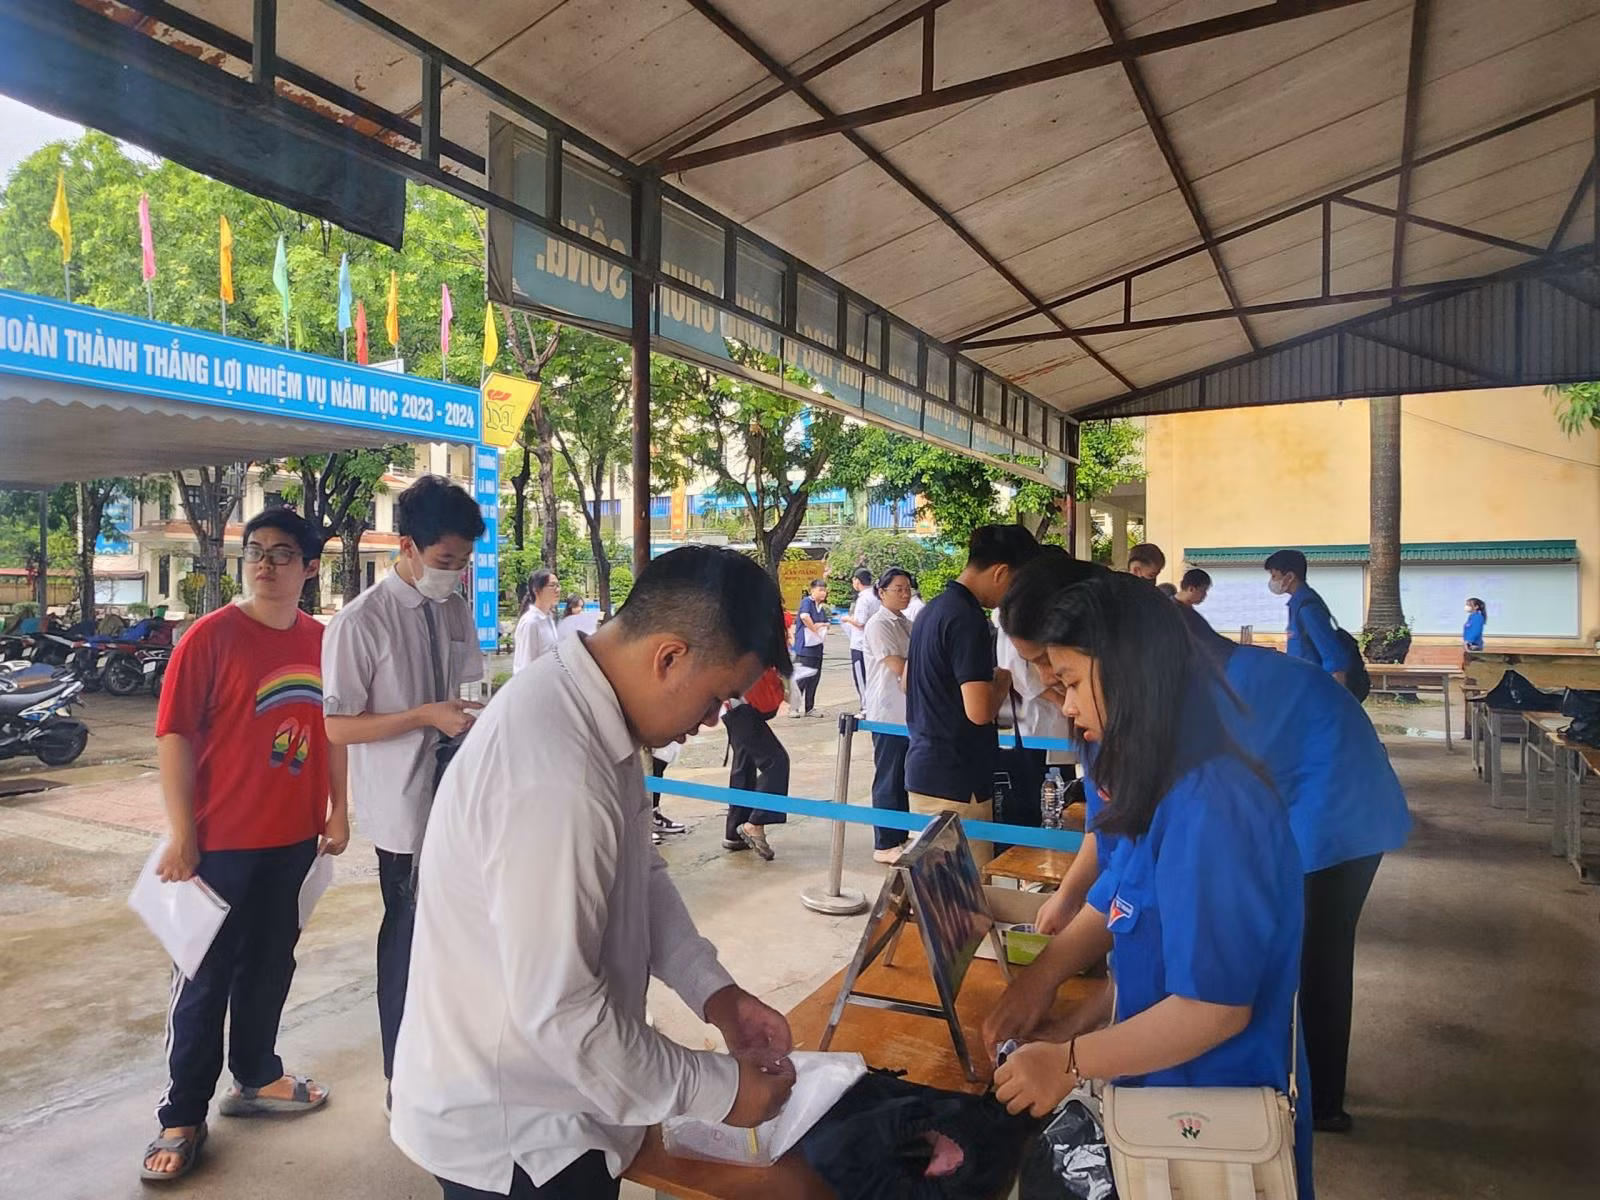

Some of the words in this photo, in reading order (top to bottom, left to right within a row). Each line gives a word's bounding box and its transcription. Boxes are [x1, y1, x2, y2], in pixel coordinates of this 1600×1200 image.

[64, 328, 138, 373] THÀNH
[143, 338, 209, 385] THẮNG
[214, 357, 242, 395] LỢI
[247, 364, 302, 403] NHIỆM
[306, 375, 327, 410] VỤ
[331, 378, 366, 411] NĂM
[370, 388, 398, 420] HỌC
[401, 395, 434, 423] 2023
[444, 402, 475, 429] 2024
